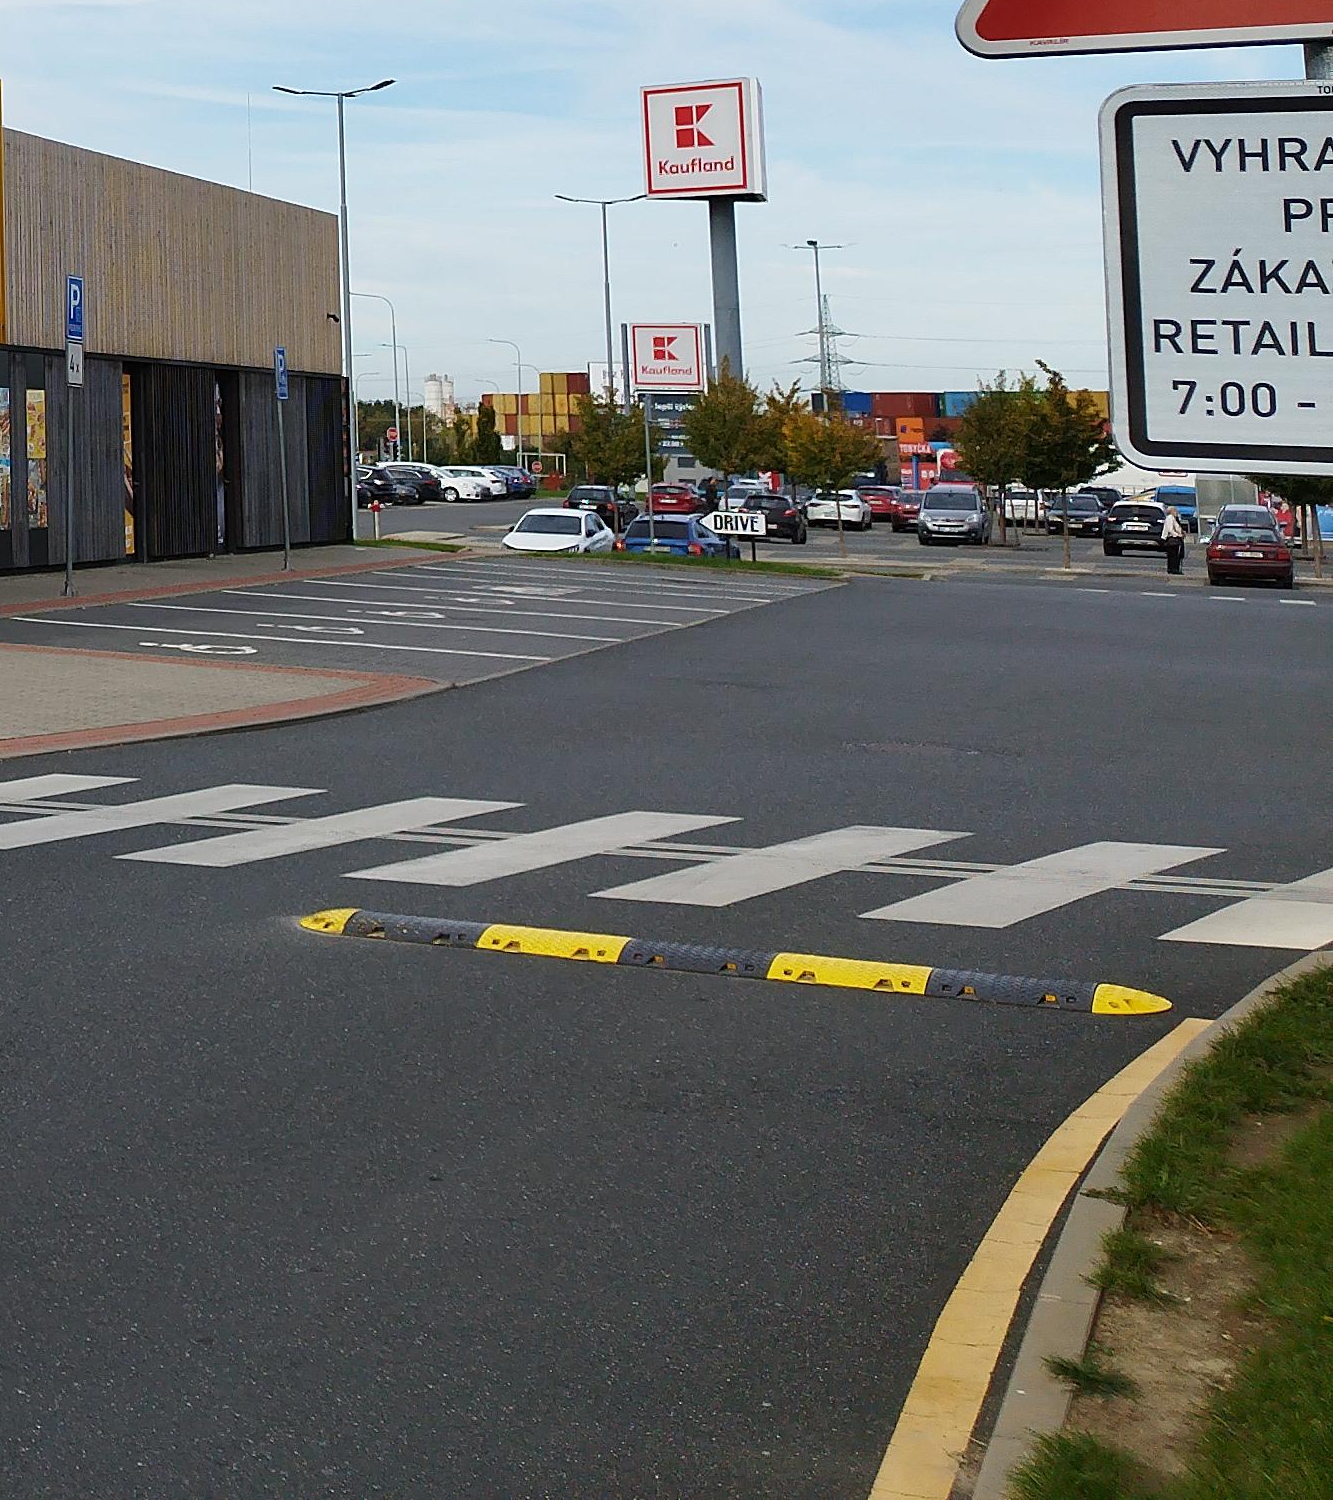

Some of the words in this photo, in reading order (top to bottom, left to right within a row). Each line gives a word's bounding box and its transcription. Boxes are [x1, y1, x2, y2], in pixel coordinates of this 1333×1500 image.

[1317, 86, 1333, 94] TO
[658, 155, 735, 176] Kaufland
[1190, 247, 1333, 295] ZÁKA
[70, 284, 81, 320] P
[1153, 318, 1333, 357] RETAIL
[641, 365, 693, 376] Kaufland
[1172, 380, 1277, 418] 7:00
[713, 514, 759, 533] DRIVE
